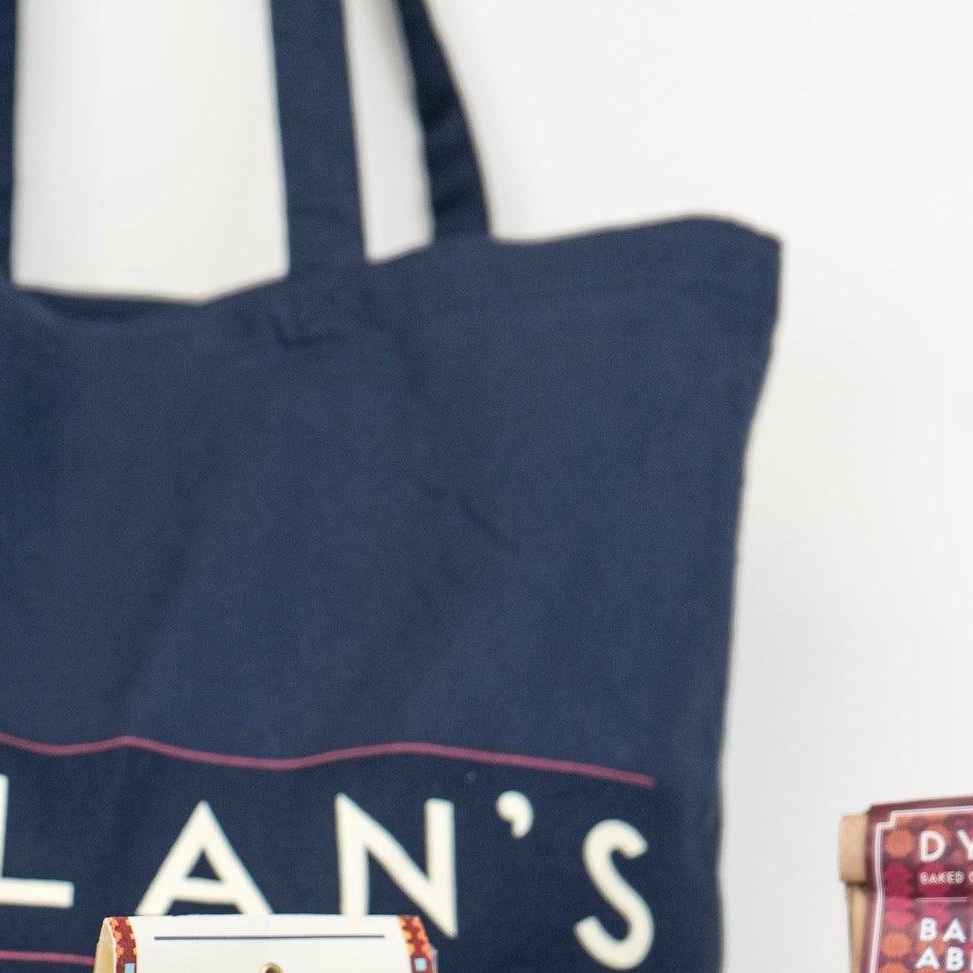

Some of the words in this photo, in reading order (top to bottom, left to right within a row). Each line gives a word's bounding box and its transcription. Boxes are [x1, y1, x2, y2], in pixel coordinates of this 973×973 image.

[920, 870, 965, 885] BAKED
[919, 916, 973, 943] BA
[915, 945, 973, 971] AB
